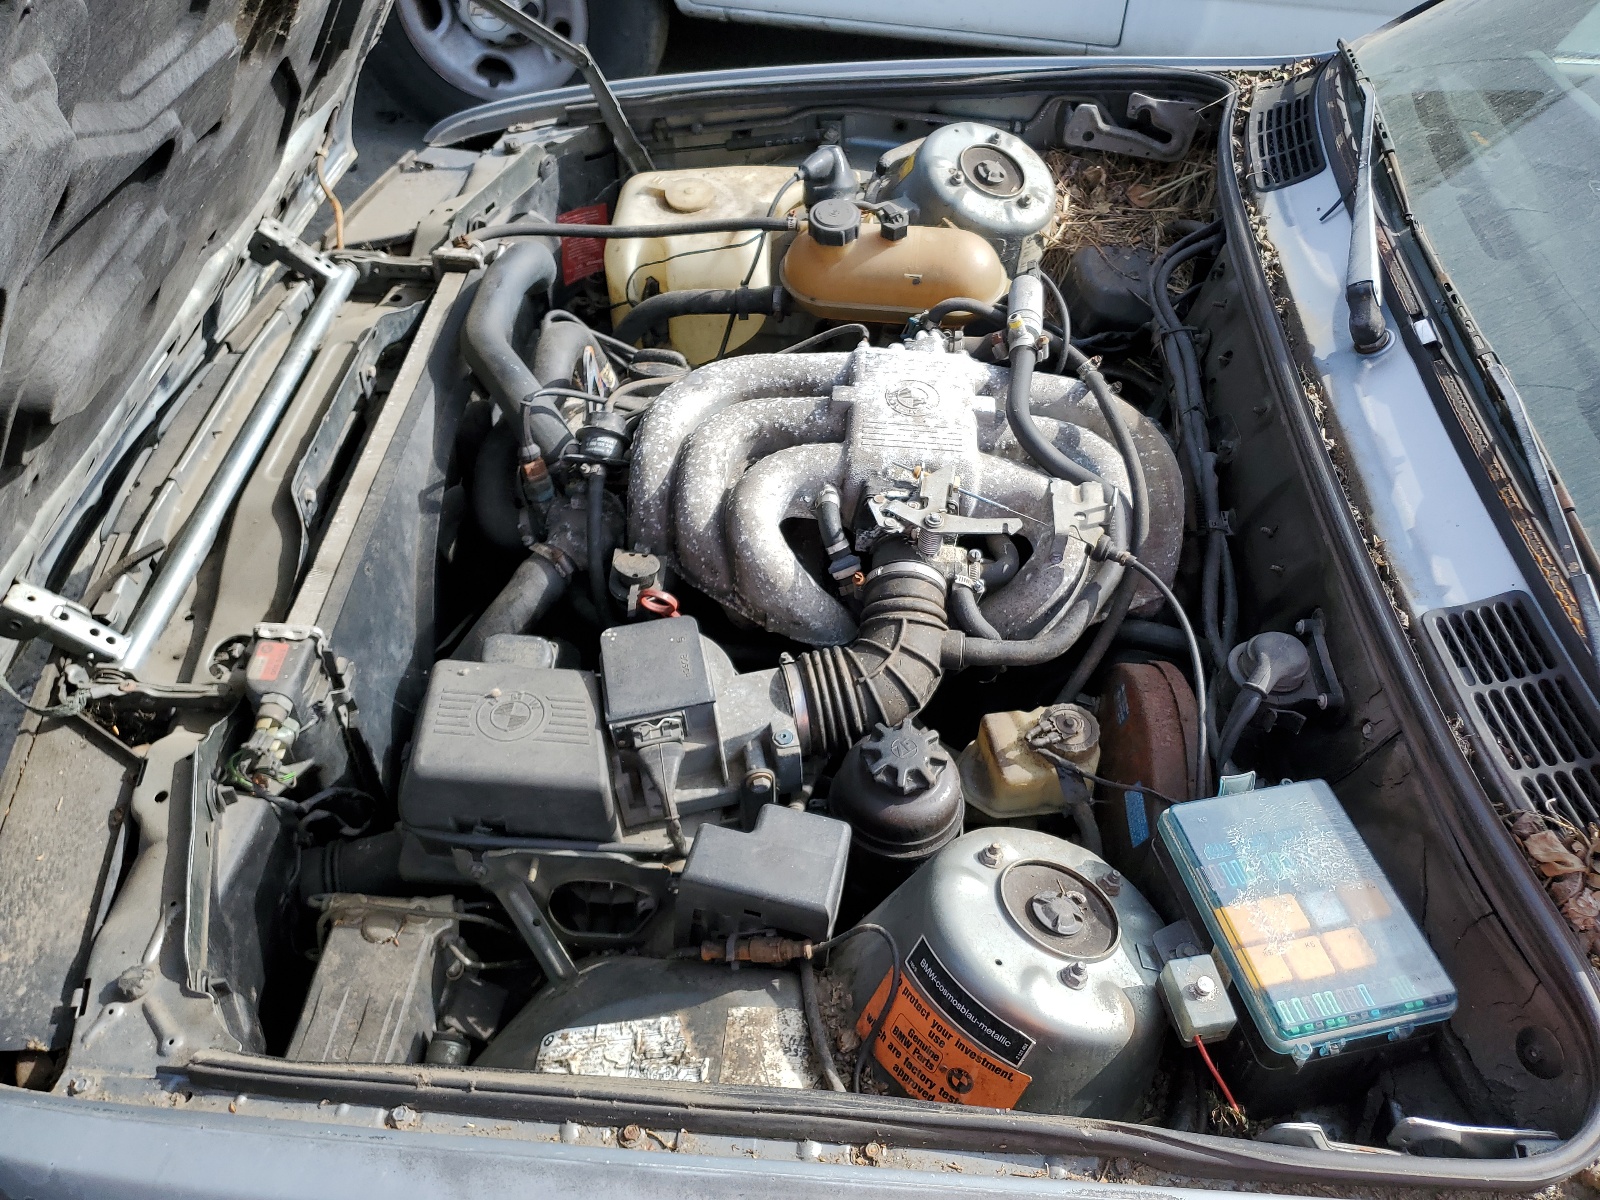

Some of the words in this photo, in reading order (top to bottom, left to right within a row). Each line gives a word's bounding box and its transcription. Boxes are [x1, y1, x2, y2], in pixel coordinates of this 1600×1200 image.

[902, 986, 931, 1021] protect
[931, 1019, 953, 1041] your
[920, 958, 1012, 1047] BMW-cosmosblau-metallic
[866, 1012, 887, 1042] wch
[887, 1042, 902, 1058] are
[903, 1057, 937, 1090] factory
[892, 1025, 913, 1049] BMW
[912, 1047, 935, 1071] Parts
[907, 1028, 940, 1062] Genuine
[928, 1029, 946, 1048] use
[892, 1063, 936, 1102] approved
